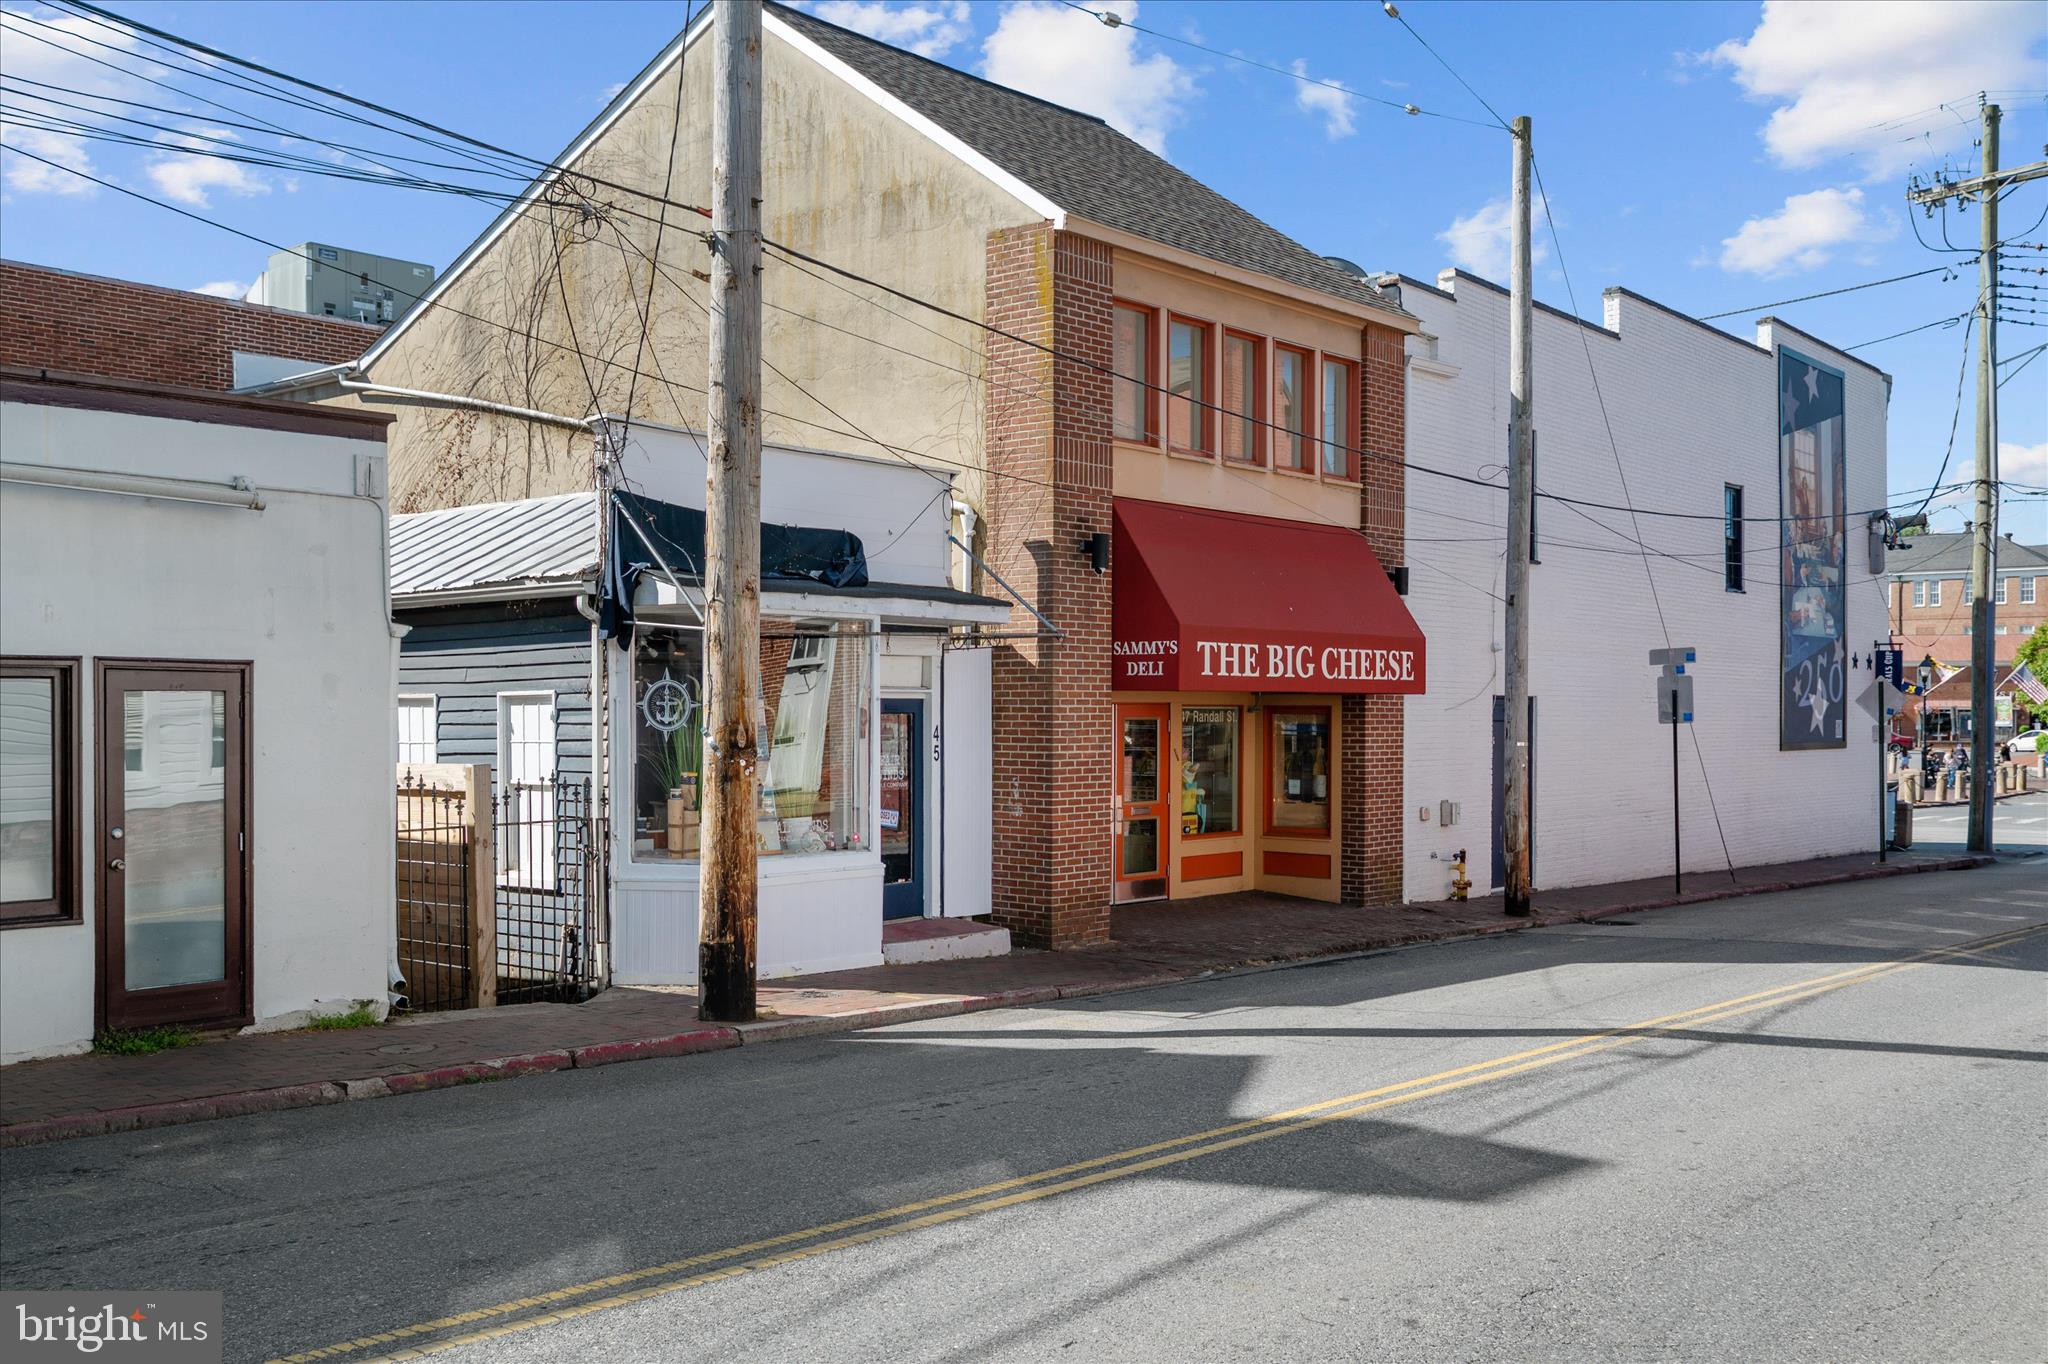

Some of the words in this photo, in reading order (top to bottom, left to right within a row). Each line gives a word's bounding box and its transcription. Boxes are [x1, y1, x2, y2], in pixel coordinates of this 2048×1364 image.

[1113, 640, 1178, 655] SAMMY'S
[1126, 661, 1165, 676] DELI
[1196, 641, 1260, 677] THE
[1266, 644, 1316, 679] BIG
[1321, 647, 1415, 681] CHEESE
[1193, 710, 1224, 723] Randall
